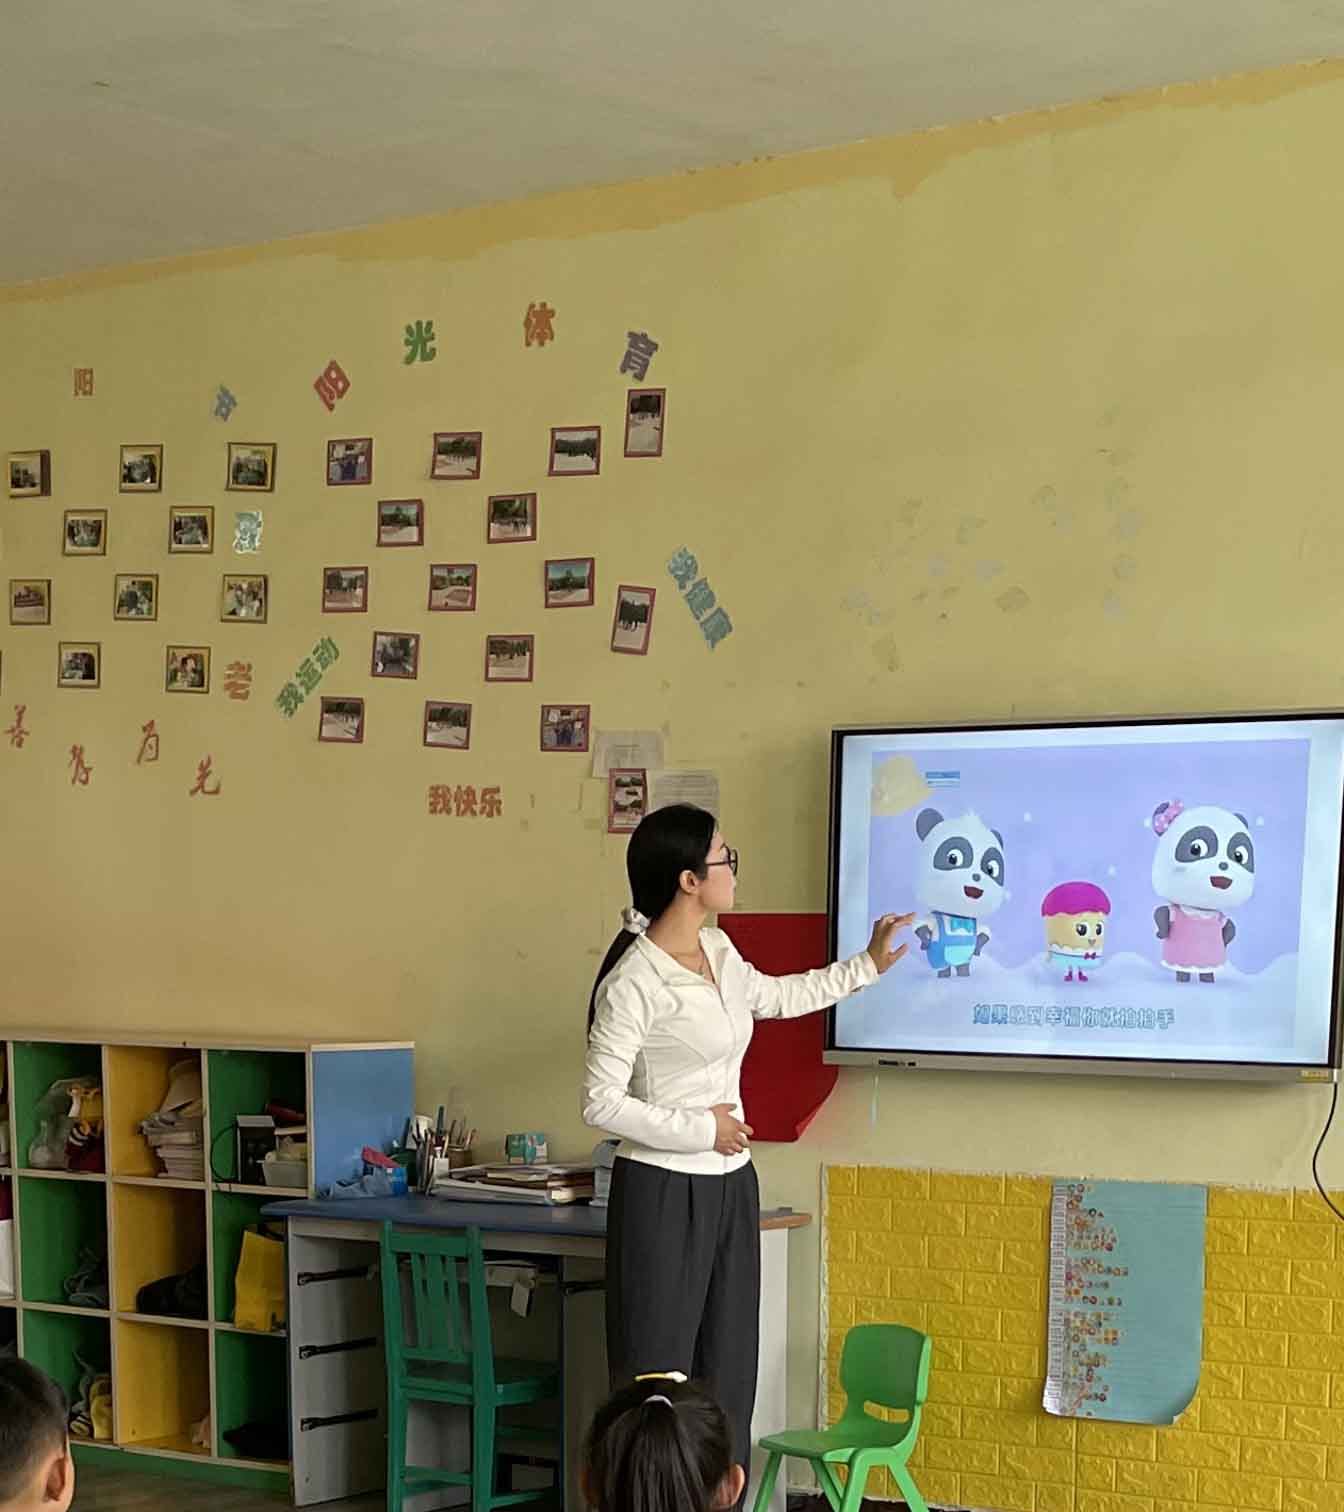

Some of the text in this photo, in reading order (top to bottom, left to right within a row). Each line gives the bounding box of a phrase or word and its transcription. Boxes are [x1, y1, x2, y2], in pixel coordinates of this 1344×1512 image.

[274, 636, 340, 719] 我运动
[428, 785, 503, 817] 我快乐
